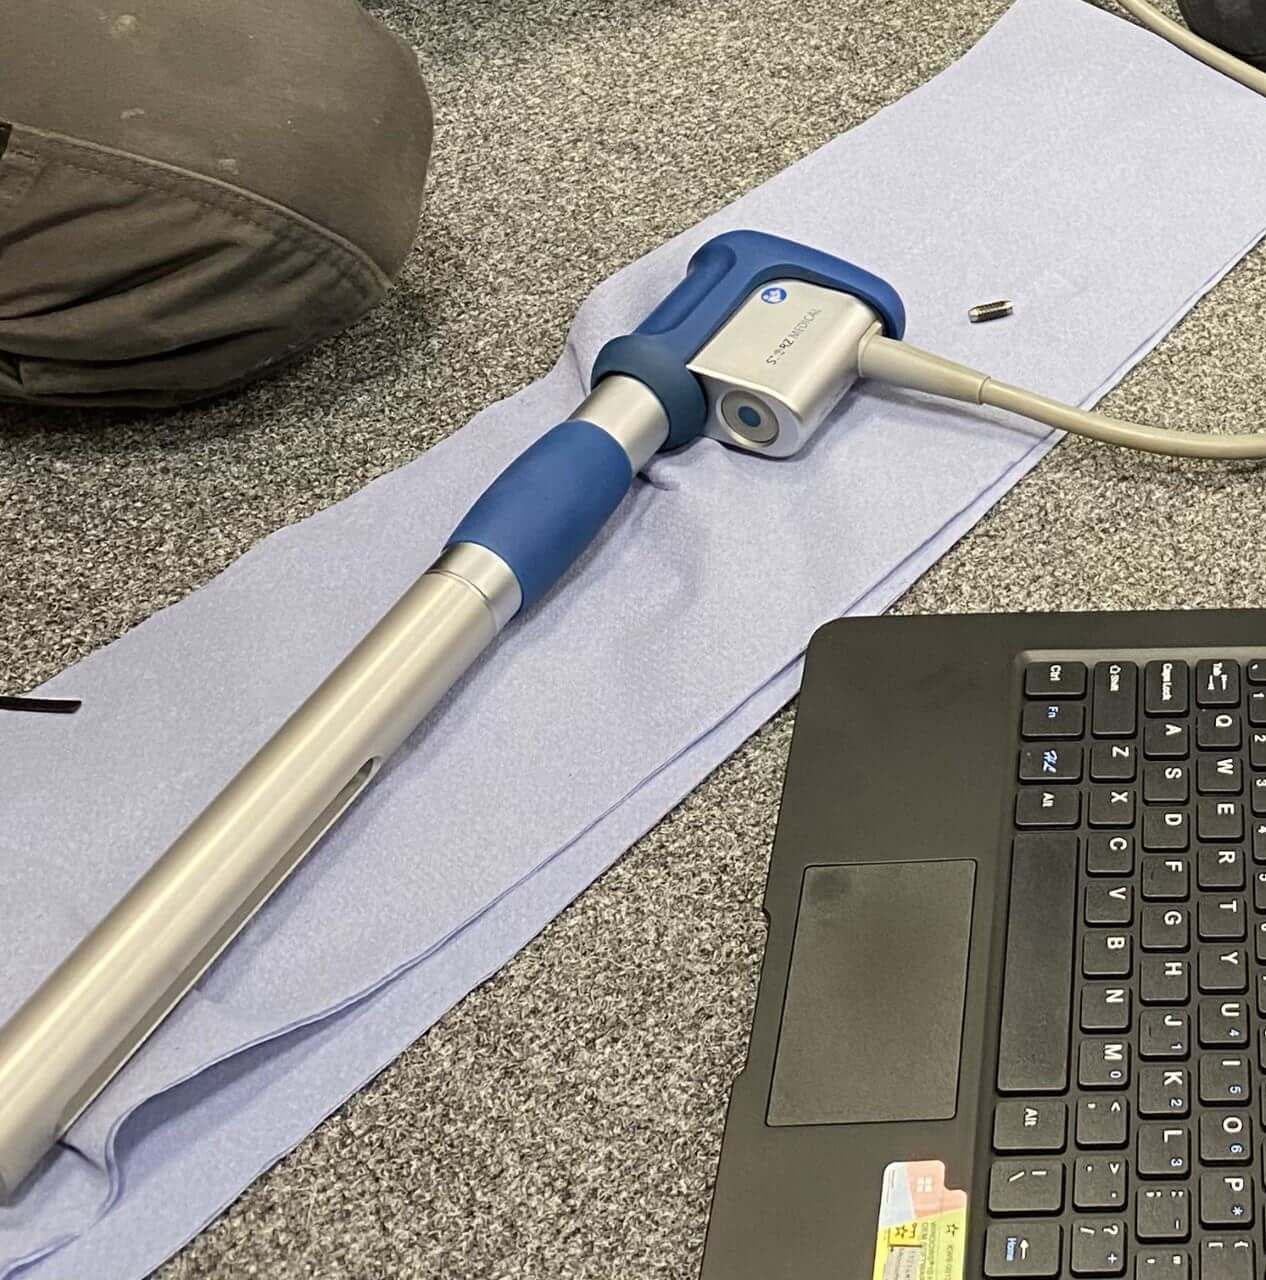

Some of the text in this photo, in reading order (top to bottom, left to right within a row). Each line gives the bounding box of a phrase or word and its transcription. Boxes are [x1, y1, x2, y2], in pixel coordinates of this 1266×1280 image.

[1050, 665, 1061, 681] Ctrl
[1162, 663, 1172, 700] Caps Lock
[1048, 707, 1058, 717] Fn
[1216, 715, 1232, 727] Q
[1166, 725, 1181, 735] A
[1113, 747, 1129, 757] Z
[1217, 759, 1233, 774] W
[1165, 768, 1182, 778] S
[1043, 793, 1054, 807] Alt
[1111, 792, 1128, 803] X
[1218, 804, 1234, 814] E
[1165, 814, 1182, 825] D
[1110, 838, 1127, 850] C
[1219, 851, 1235, 863] R
[1166, 862, 1182, 872] F
[1109, 888, 1126, 899] V
[1220, 901, 1236, 912] T
[1165, 911, 1182, 925] G
[1108, 937, 1125, 949] B
[1221, 952, 1238, 964] Y
[1165, 963, 1182, 975] H
[1106, 990, 1124, 1002] N
[1221, 1004, 1239, 1016] U
[1165, 1016, 1182, 1026] J
[1105, 1045, 1122, 1060] M
[1164, 1072, 1182, 1085] K
[1025, 1109, 1037, 1126] Alt
[1223, 1117, 1242, 1133] O
[1164, 1130, 1182, 1142] L
[1231, 1145, 1242, 1153] 6
[1225, 1178, 1243, 1191] P
